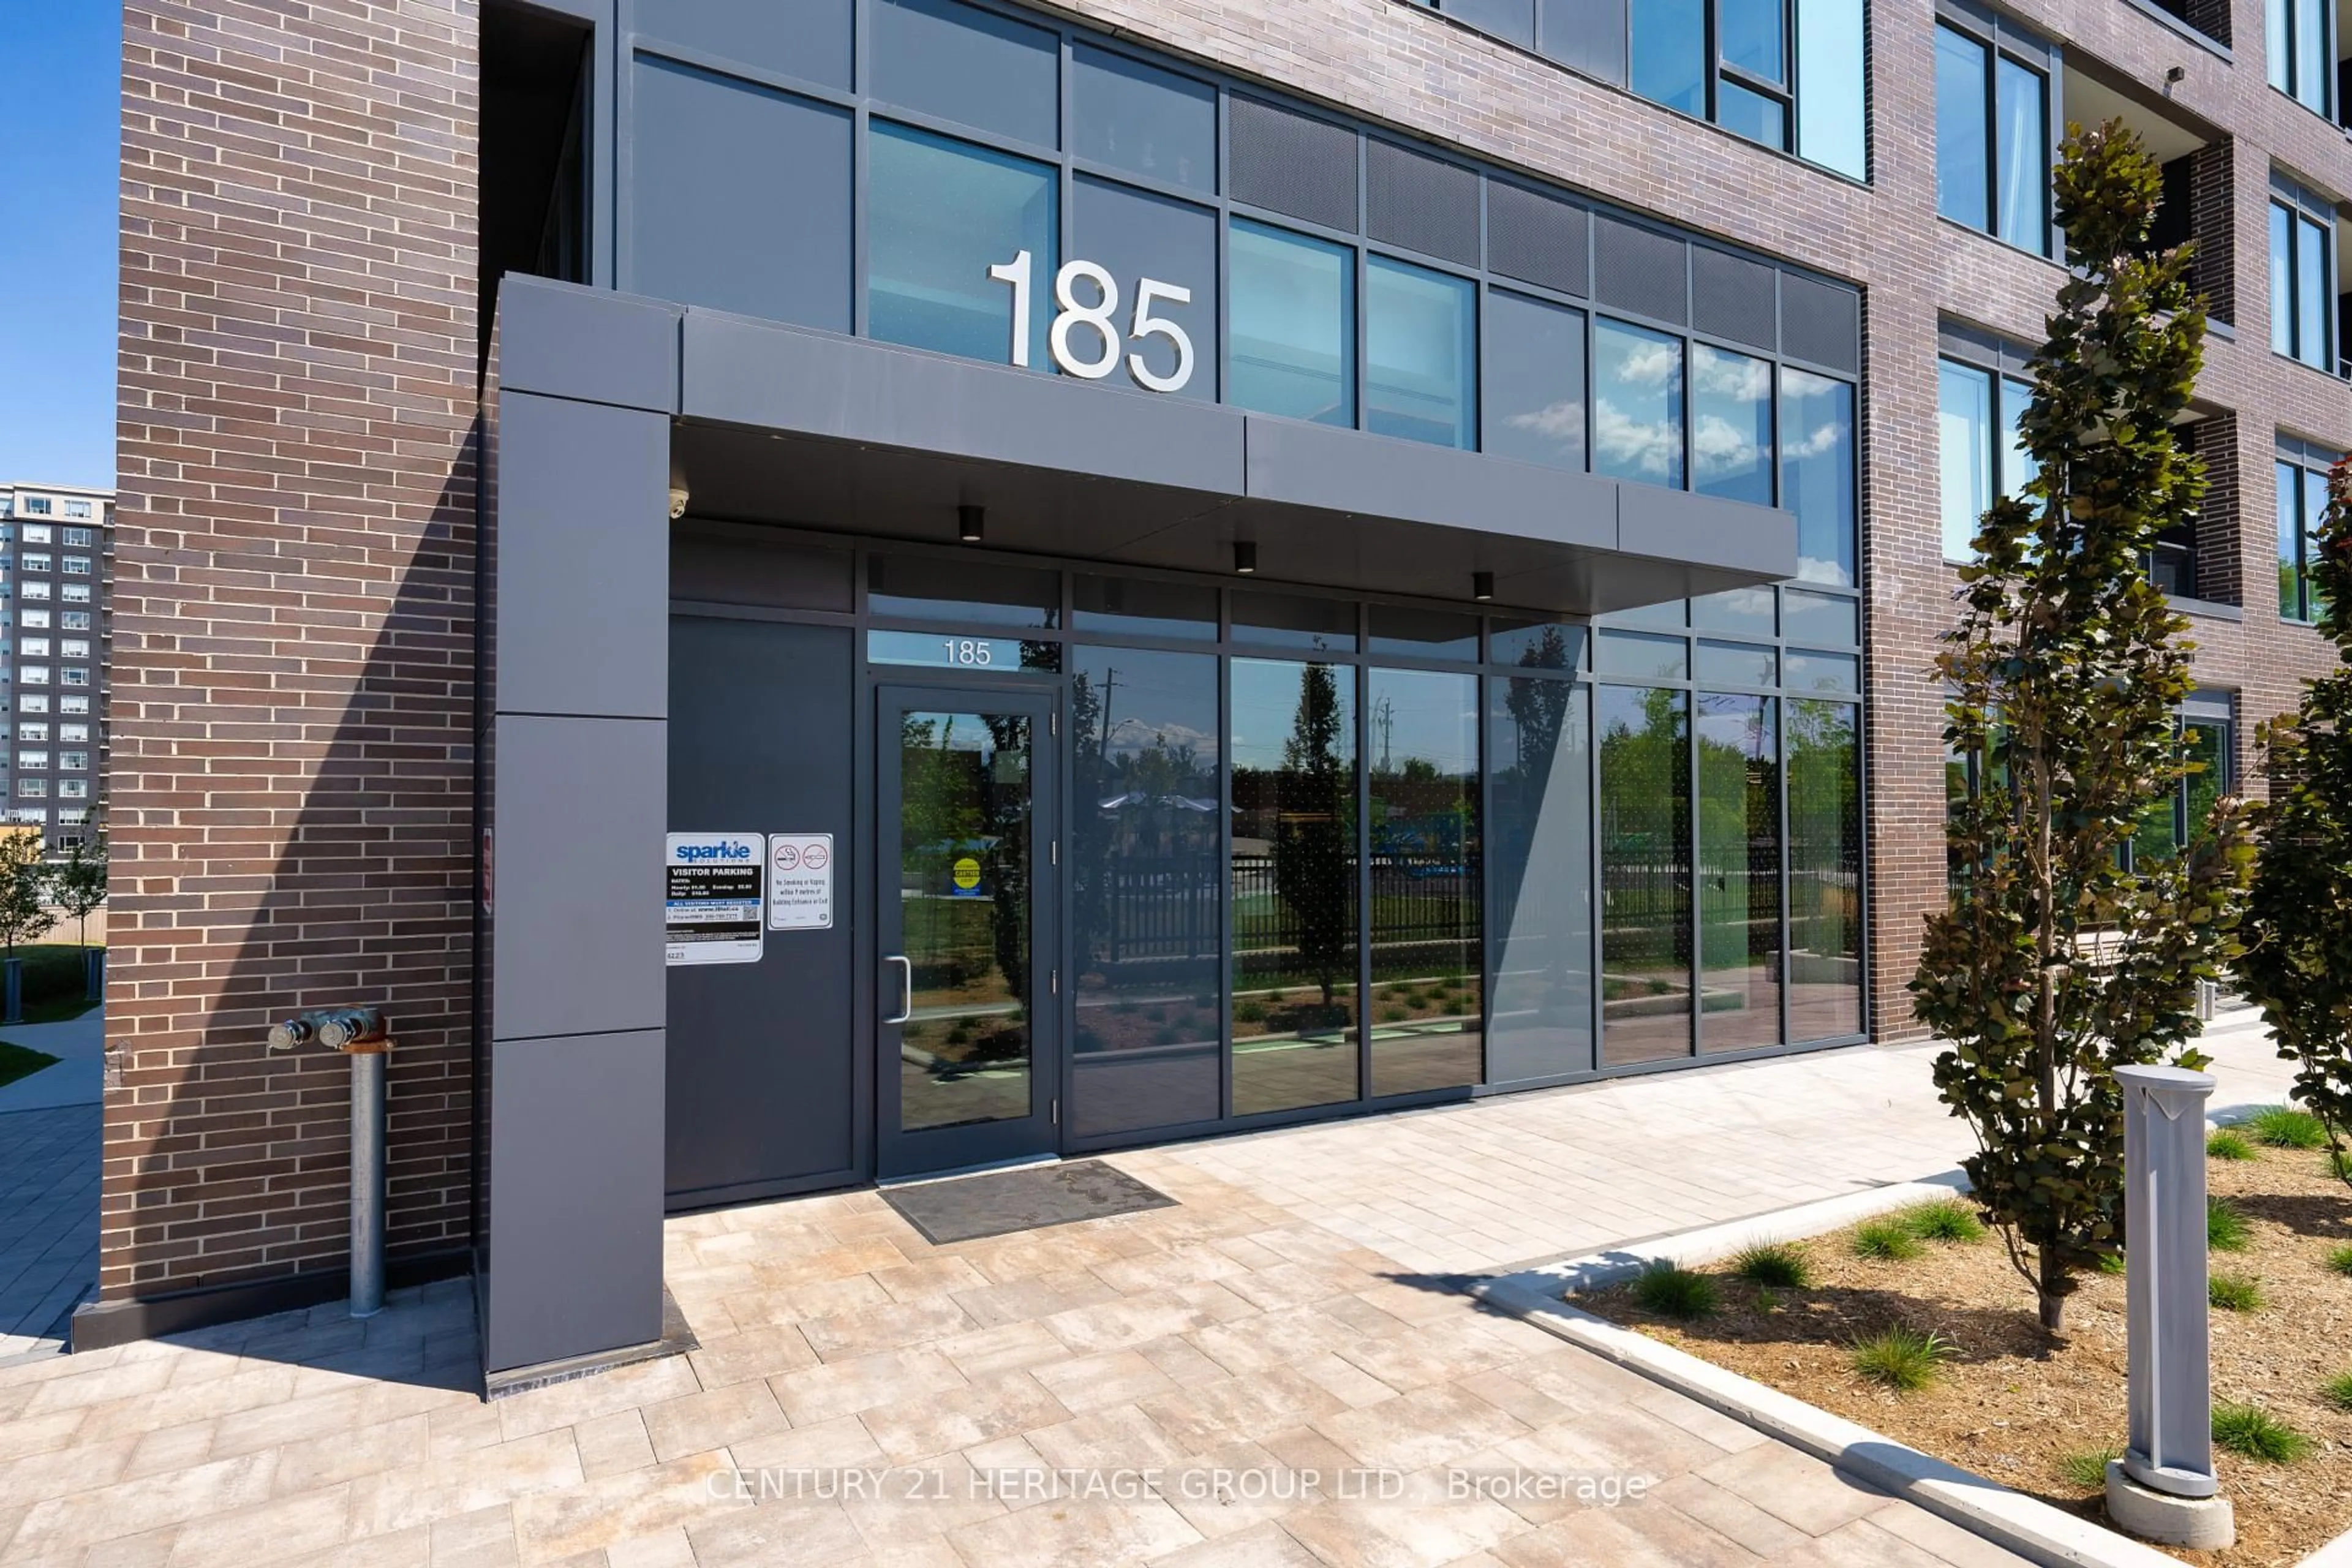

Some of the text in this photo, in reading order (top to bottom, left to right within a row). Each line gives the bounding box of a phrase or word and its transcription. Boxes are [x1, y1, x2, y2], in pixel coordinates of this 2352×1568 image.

[987, 250, 1194, 393] 185
[944, 639, 990, 665] 185
[673, 868, 710, 876] VISITOR
